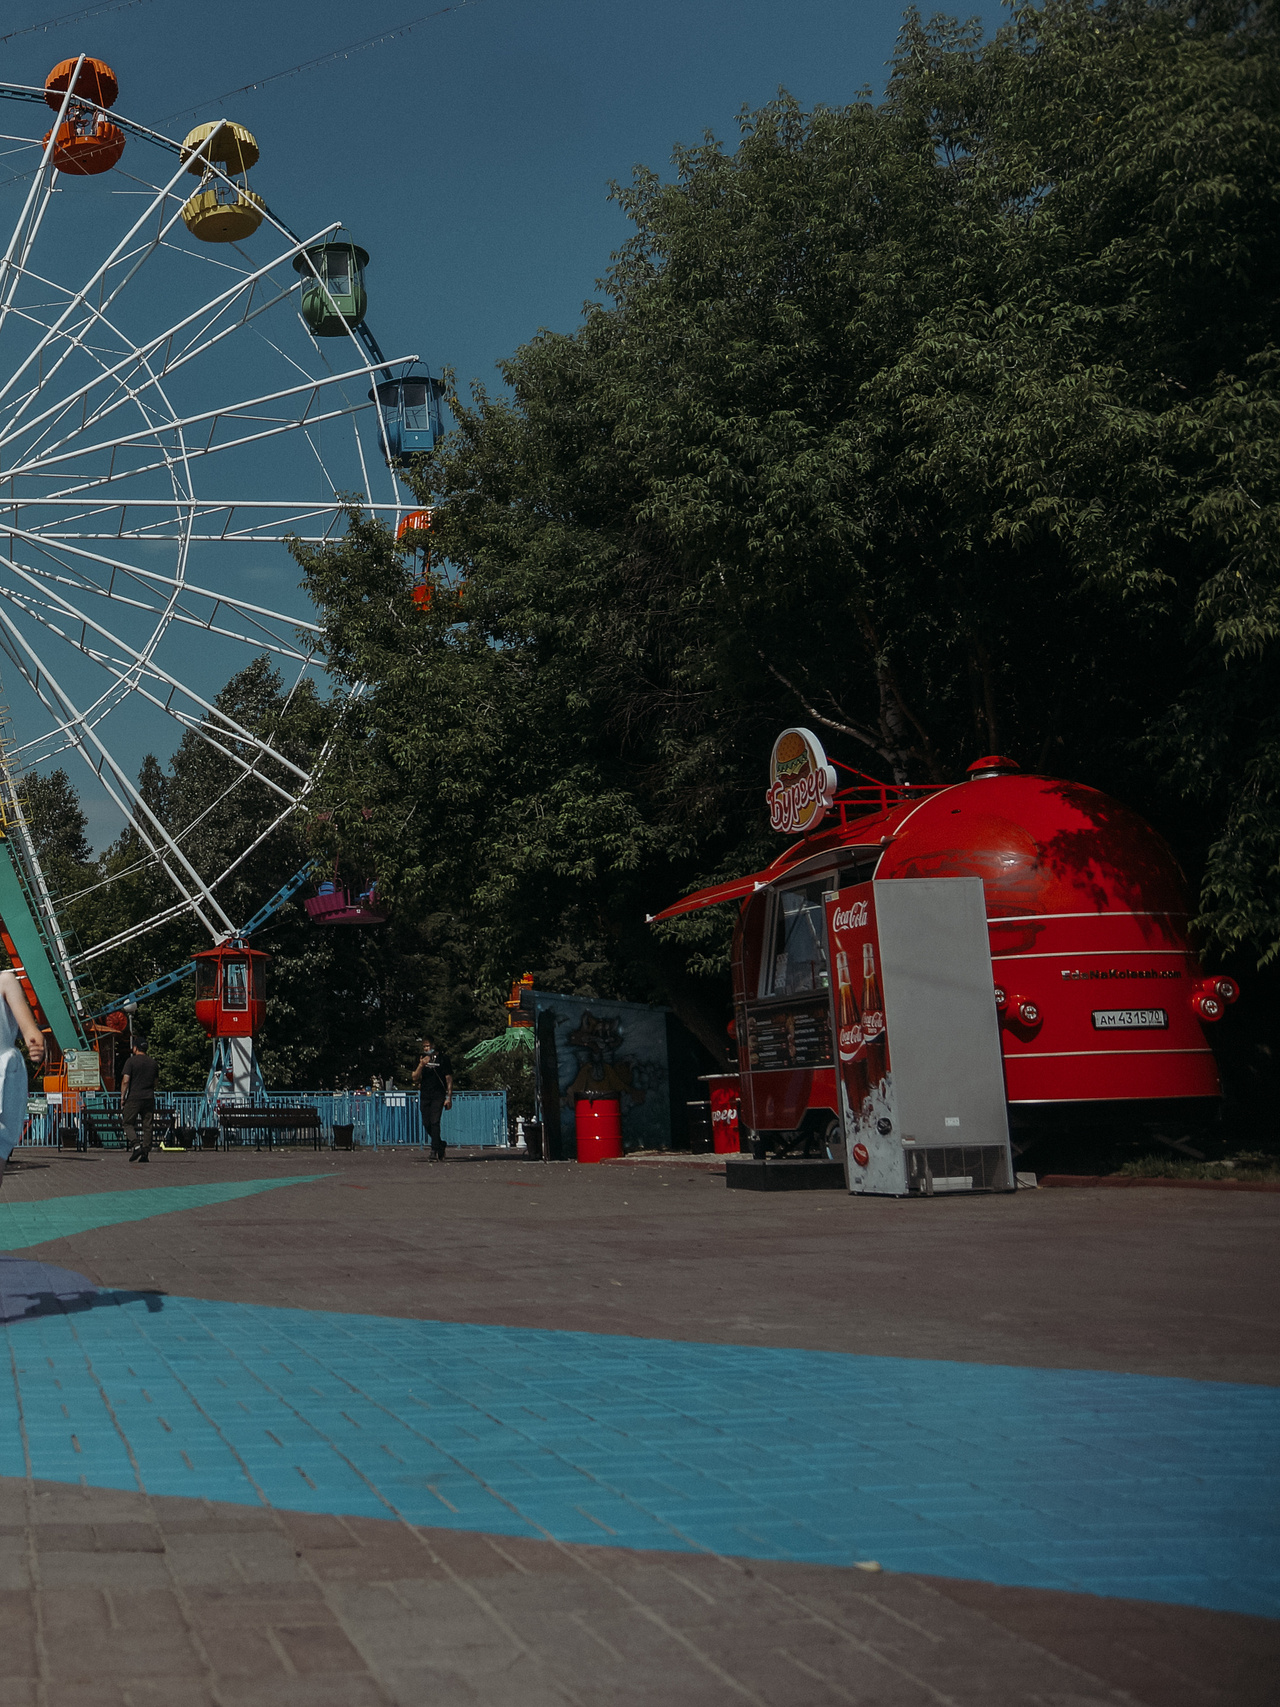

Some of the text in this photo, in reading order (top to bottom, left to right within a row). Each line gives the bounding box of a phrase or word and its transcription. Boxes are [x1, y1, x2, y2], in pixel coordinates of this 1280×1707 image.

[766, 767, 827, 832] Бургер
[832, 900, 869, 933] Coca-Cola
[1118, 1011, 1147, 1025] 4315
[1148, 1010, 1160, 1021] 70
